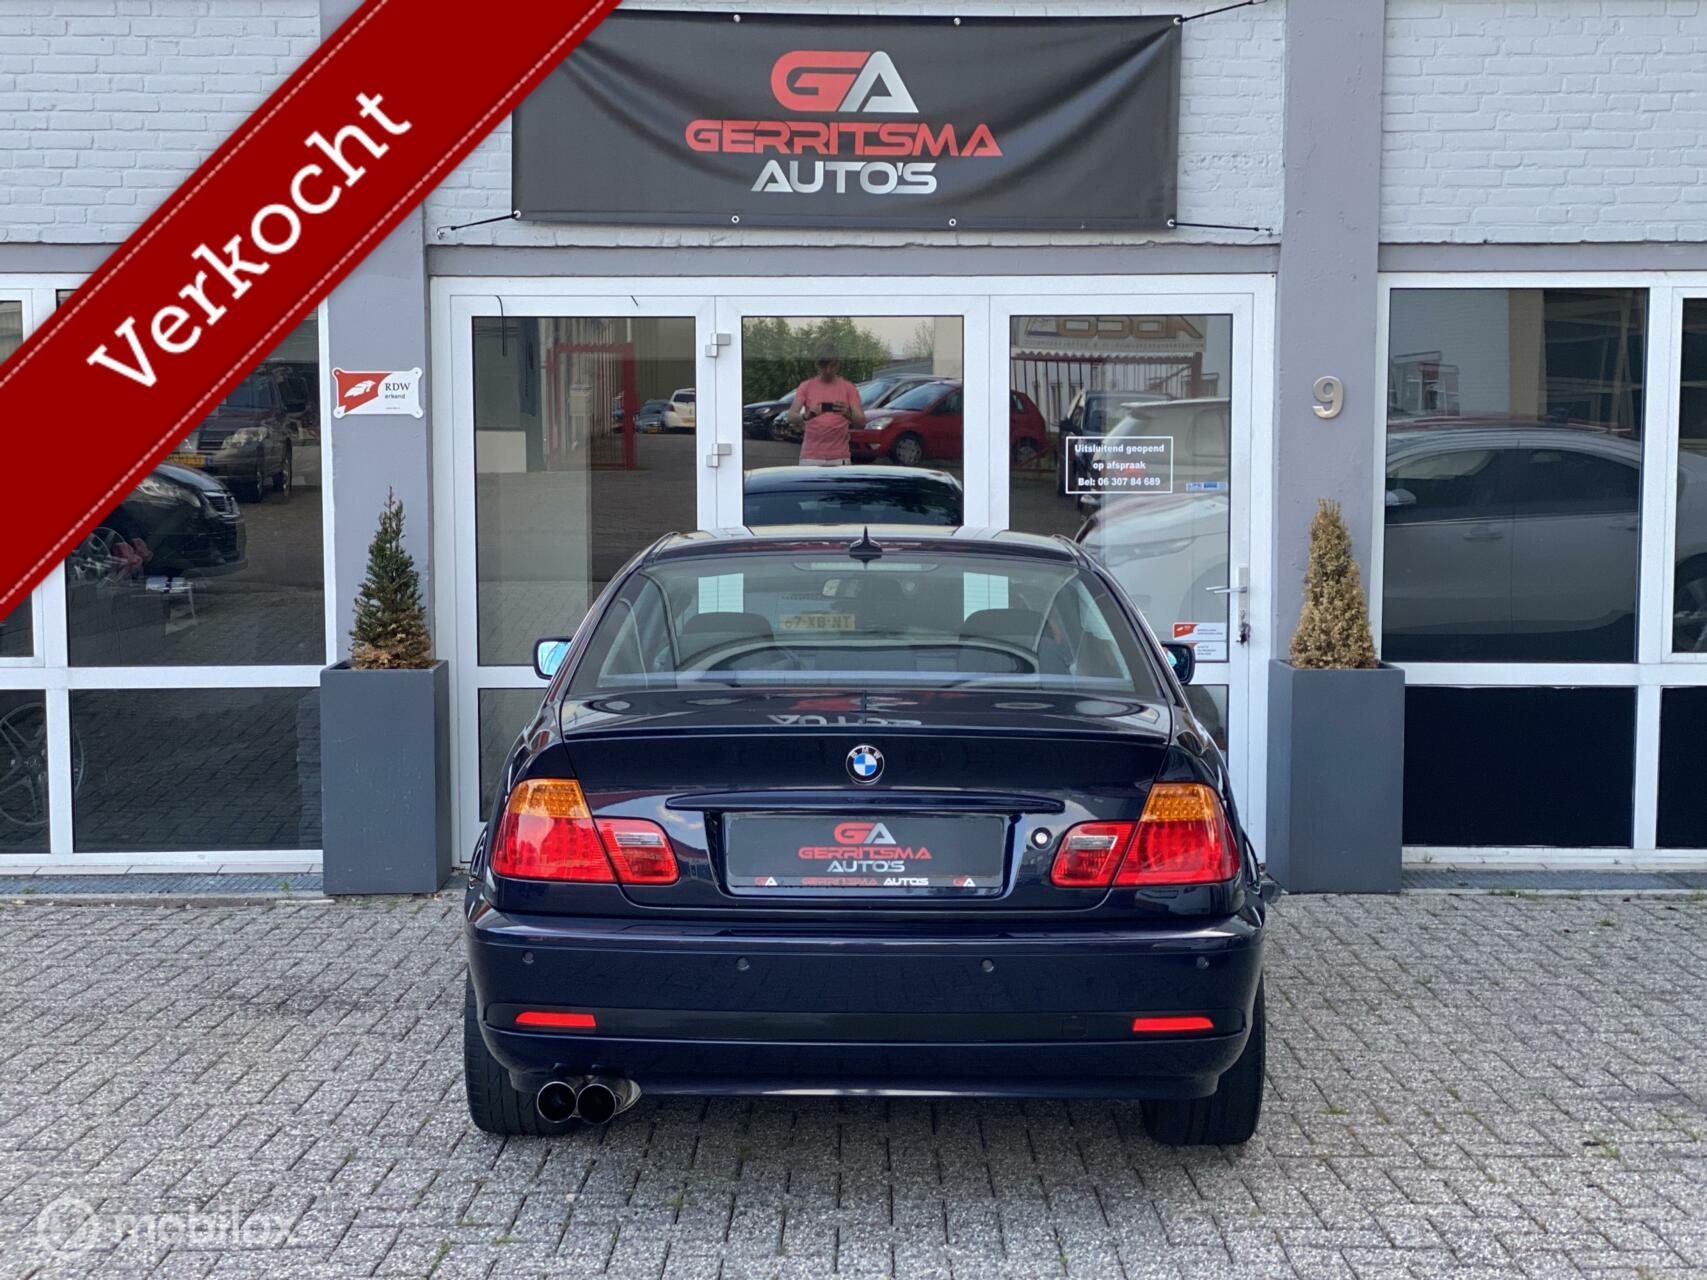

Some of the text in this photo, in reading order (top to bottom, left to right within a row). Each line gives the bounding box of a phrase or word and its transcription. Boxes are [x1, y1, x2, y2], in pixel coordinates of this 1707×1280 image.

[770, 50, 919, 113] GA
[685, 119, 1003, 157] GERRITSMA
[751, 159, 938, 194] AUTO'S
[384, 382, 411, 391] RDW
[1312, 375, 1344, 419] 9
[1074, 444, 1165, 455] Uitsluitend geopend
[1092, 461, 1146, 471] op afspraak
[1097, 477, 1110, 487] 06
[1111, 477, 1128, 487] 307
[1130, 477, 1142, 487] 84
[1144, 477, 1161, 487] 689
[834, 822, 897, 844] GA
[798, 847, 933, 860] GERRITSMA
[826, 860, 906, 873] AUTO'S
